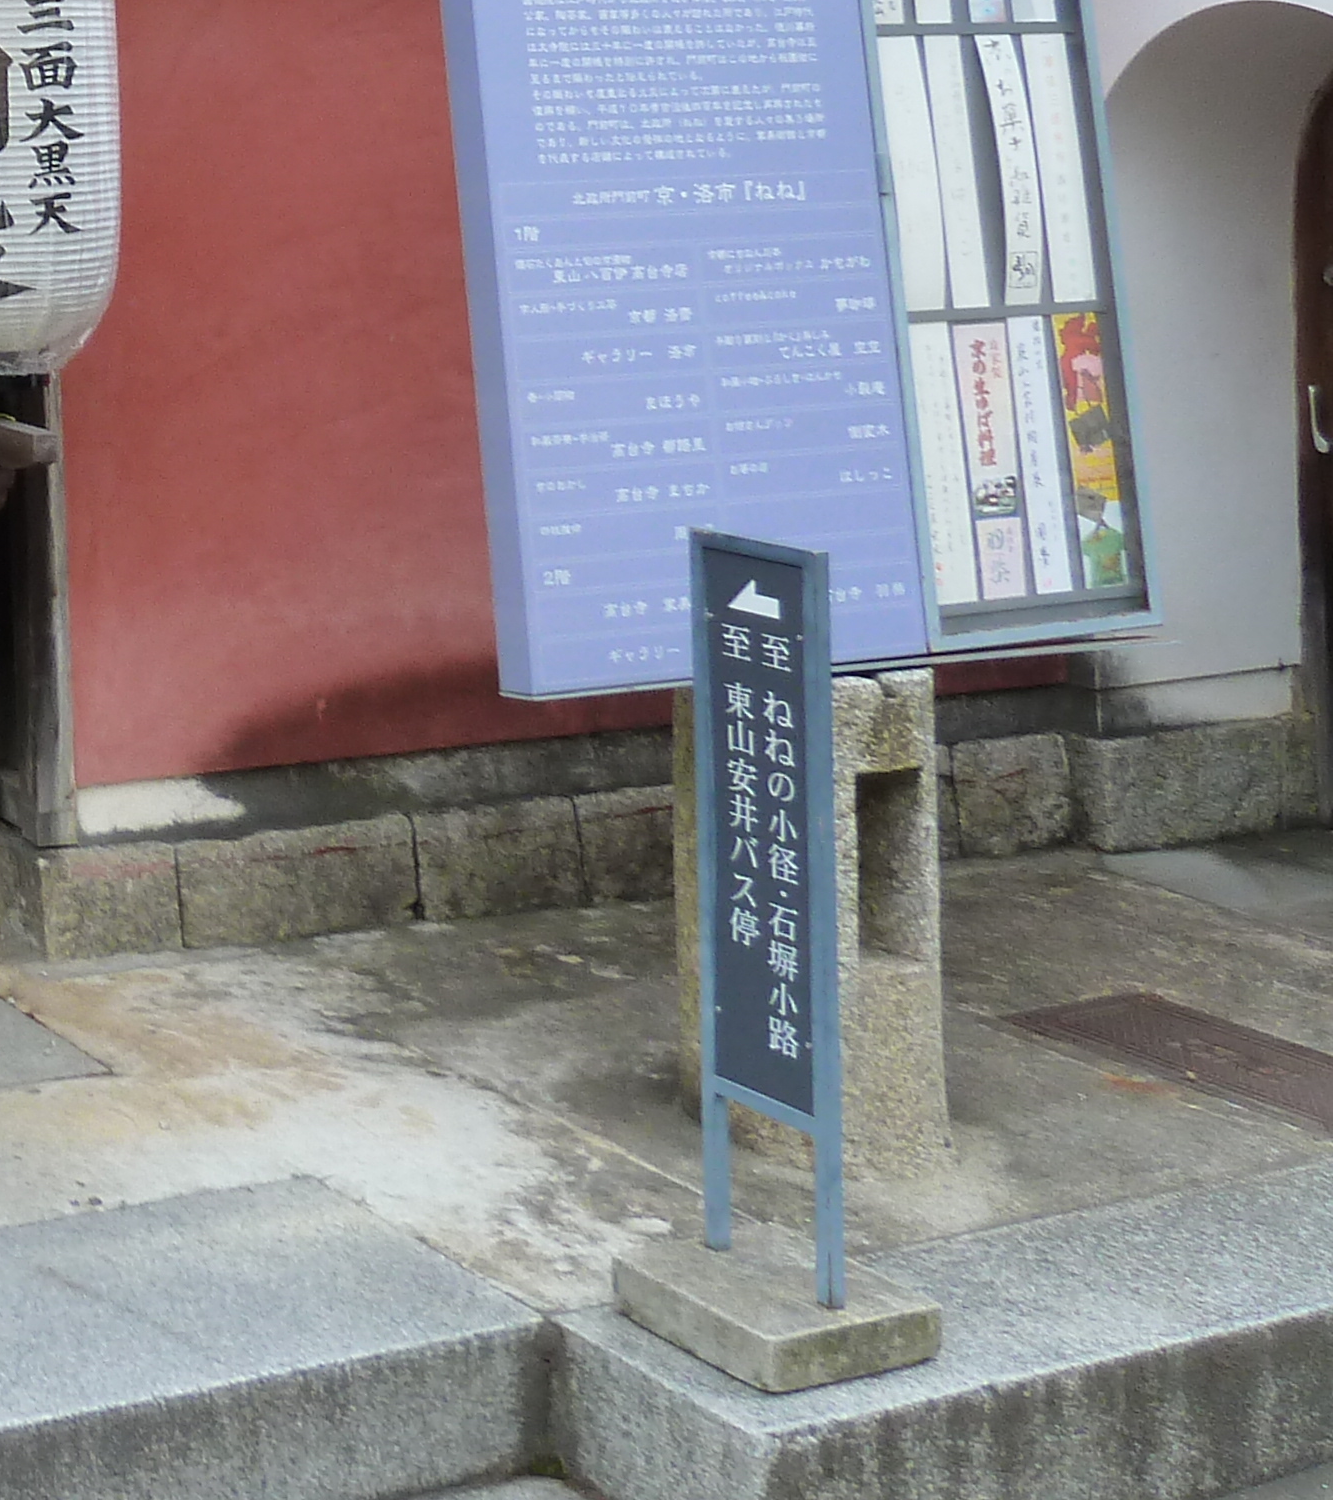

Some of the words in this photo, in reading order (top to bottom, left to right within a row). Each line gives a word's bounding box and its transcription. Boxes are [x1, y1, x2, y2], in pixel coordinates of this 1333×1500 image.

[514, 225, 541, 242] 1階
[581, 348, 653, 364] ギャラリー
[839, 466, 893, 482] はしっこ
[543, 569, 572, 586] 2階
[721, 622, 752, 664] 至
[608, 645, 681, 663] ギャラリー
[761, 632, 794, 674] 至
[723, 680, 762, 948] 東山安井バス停
[762, 690, 800, 1061] ねねの小径・石塀小路
